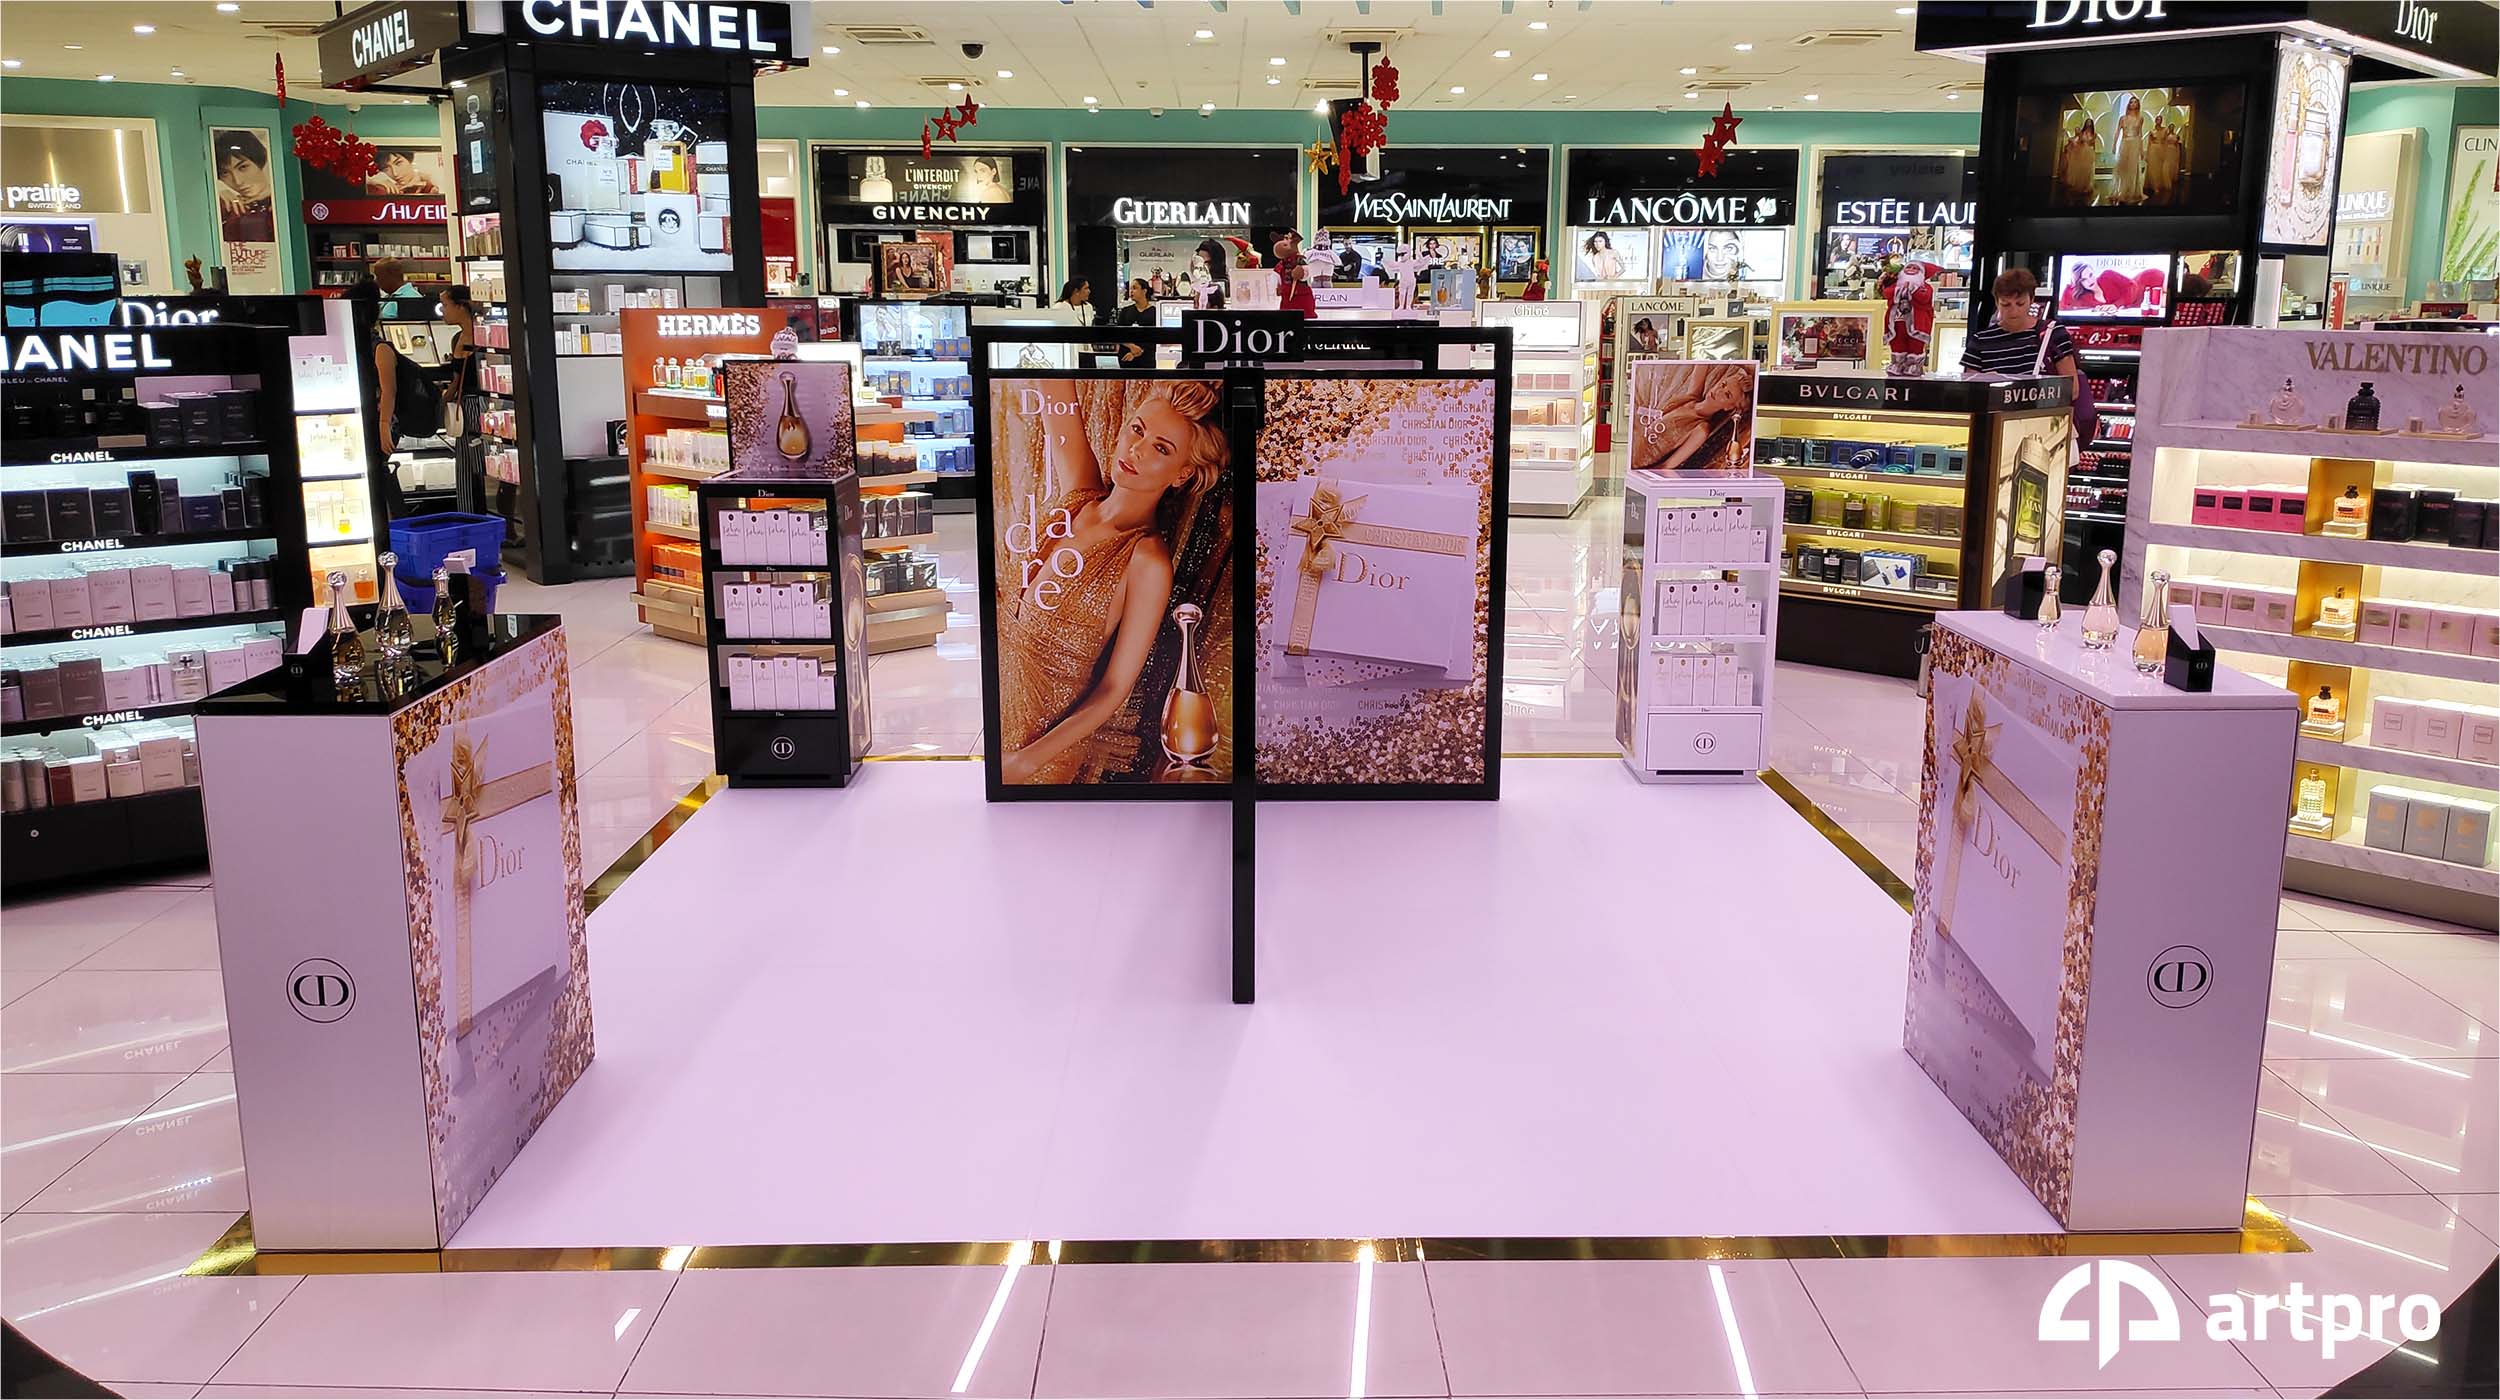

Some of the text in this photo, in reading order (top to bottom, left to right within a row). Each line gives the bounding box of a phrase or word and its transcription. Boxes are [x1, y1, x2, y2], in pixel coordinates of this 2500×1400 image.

[522, 0, 777, 52] CHANEL
[2395, 1, 2439, 45] Dior
[352, 8, 415, 69] CHANEL
[906, 168, 960, 183] L'INTERDIT
[7, 183, 81, 209] prairie
[873, 206, 991, 221] GIVENCHY
[1114, 197, 1251, 225] GUERLAIN
[1587, 192, 1747, 224] LANCÔME
[122, 300, 219, 326] Dior
[1513, 304, 1550, 317] Chloé
[1631, 301, 1685, 312] LANCÔME
[657, 313, 761, 336] HERMÈS
[1191, 319, 1295, 354] Dior
[2304, 341, 2489, 376] VALENTINO
[1019, 388, 1080, 416] Dior
[1799, 384, 1911, 402] BVLGARI
[2003, 385, 2062, 404] BVLGARI
[1833, 413, 1872, 421] BVLGARI
[50, 451, 115, 464] CHANEL
[1829, 472, 1868, 480] BVLGARI
[1709, 489, 1727, 497] Dior
[1826, 530, 1865, 539] BVLGARI
[61, 538, 125, 553] CHANEL
[1332, 551, 1411, 590] Dior
[1823, 587, 1861, 596] BVLGARI
[71, 624, 135, 640] CHANEL
[82, 710, 145, 727] CHANEL
[1971, 802, 2022, 889] Dior
[478, 834, 526, 890] Dior
